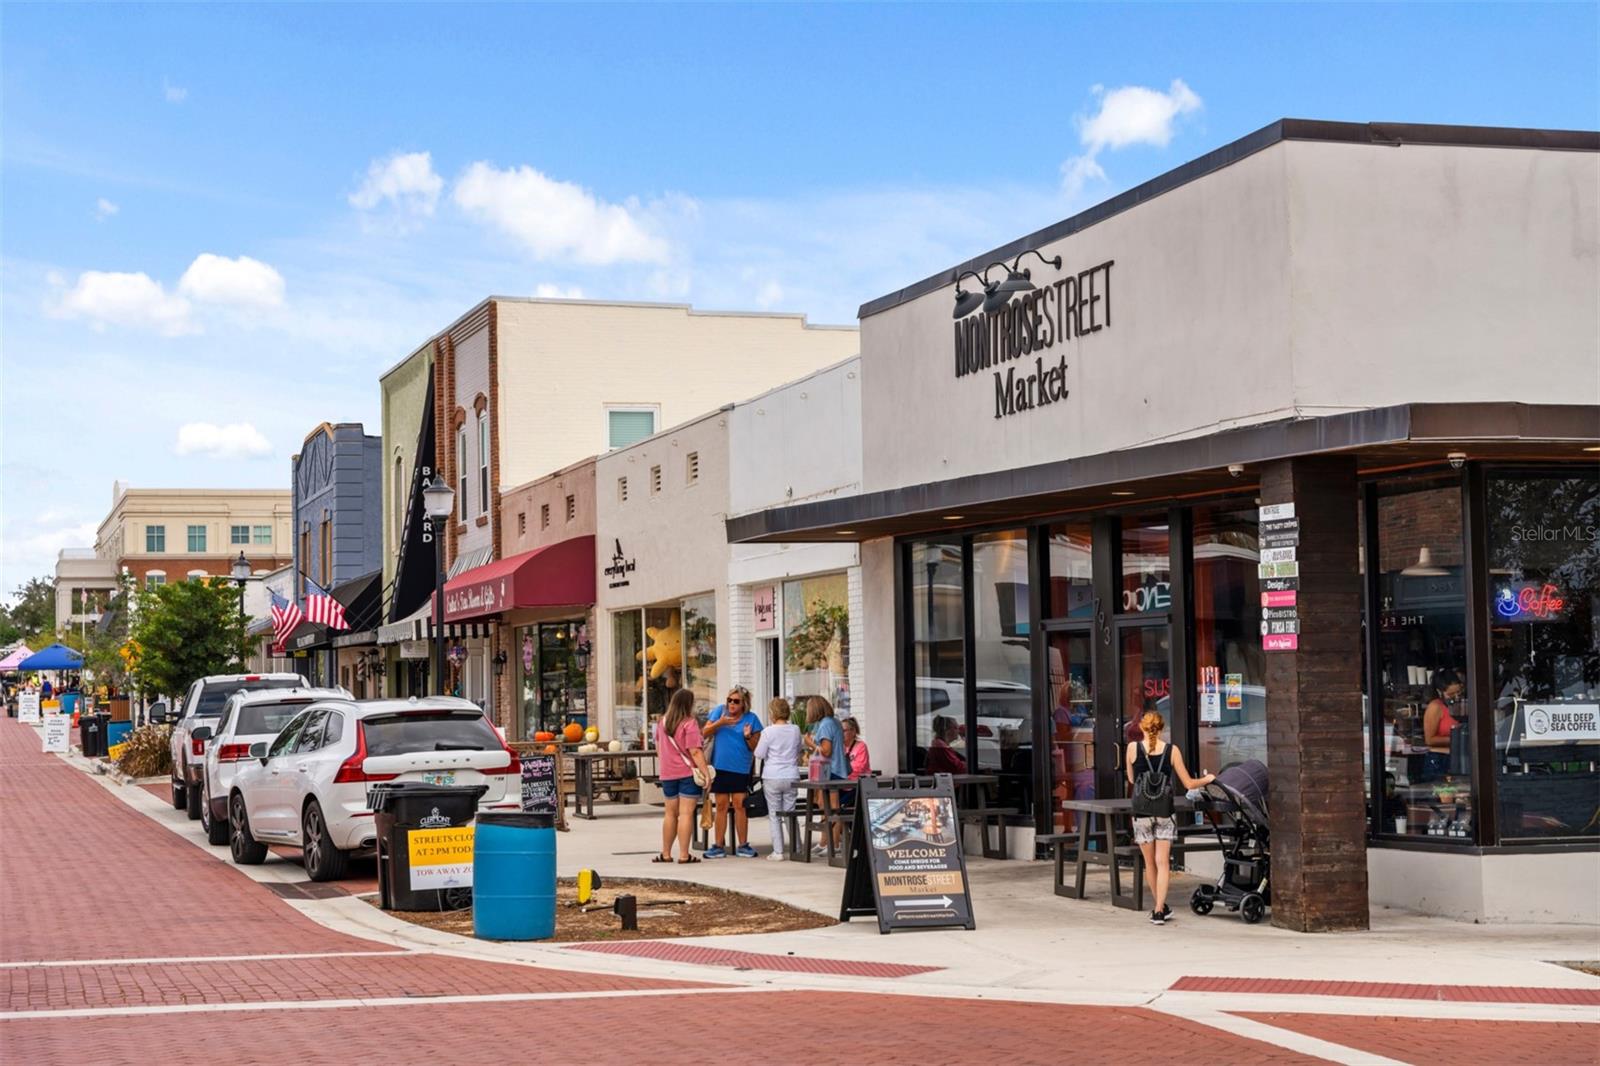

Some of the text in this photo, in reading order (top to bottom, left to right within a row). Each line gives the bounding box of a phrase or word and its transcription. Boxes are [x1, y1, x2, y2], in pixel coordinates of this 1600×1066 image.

[994, 355, 1069, 419] Market
[1519, 583, 1565, 617] Coffee
[1552, 713, 1594, 722] BLUE DEEP
[1551, 722, 1596, 731] SEA COFFEE
[413, 834, 475, 845] STREETS CLO
[416, 848, 428, 856] AT
[429, 847, 435, 855] 2
[436, 847, 450, 855] PM
[886, 848, 946, 858] WELCOME
[436, 867, 460, 875] AWAY
